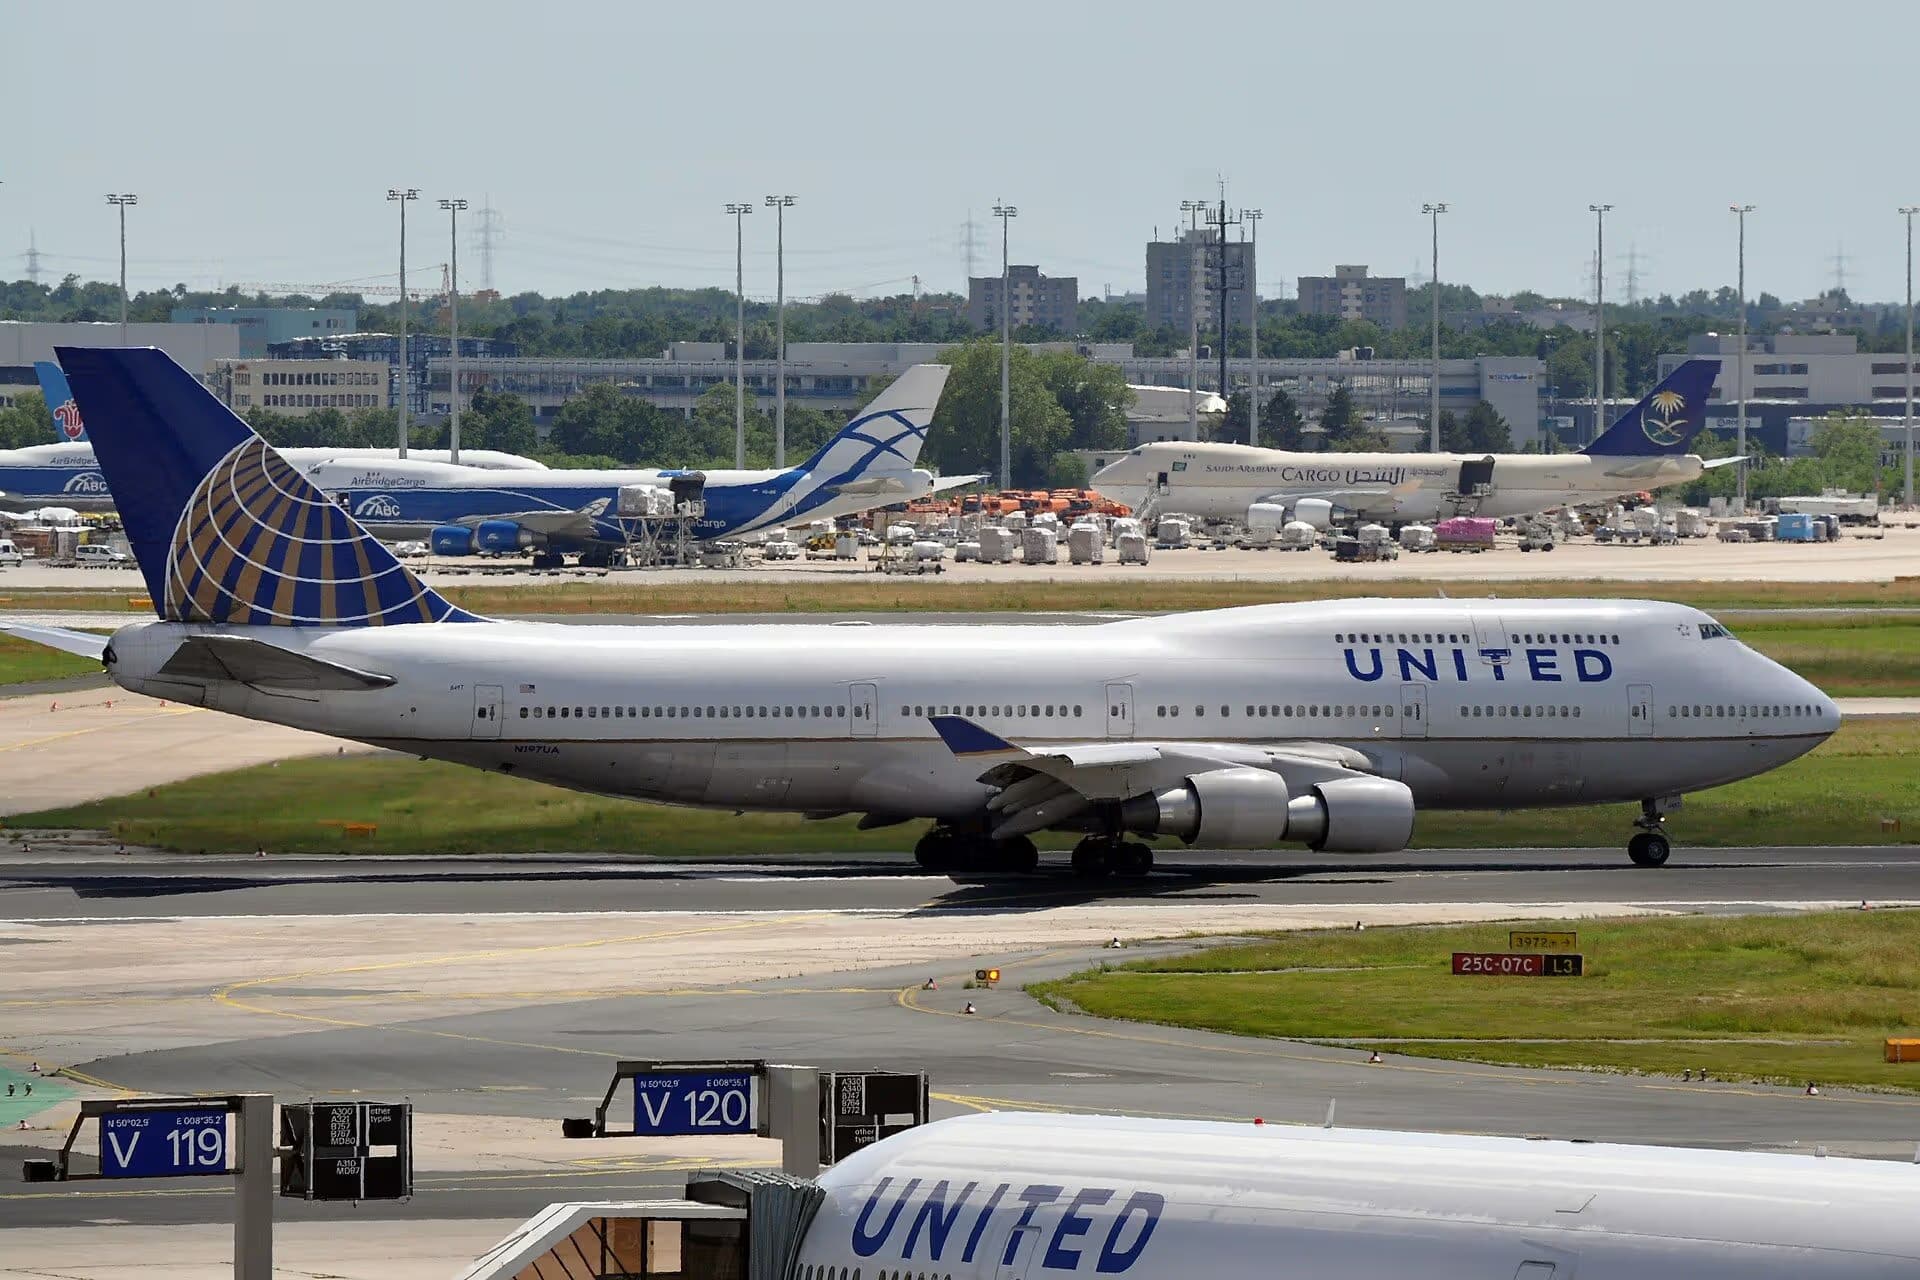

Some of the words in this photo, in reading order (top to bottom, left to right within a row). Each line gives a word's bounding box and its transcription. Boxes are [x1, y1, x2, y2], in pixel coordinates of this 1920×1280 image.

[1281, 467, 1340, 481] CARGO
[82, 482, 108, 492] ABC
[351, 477, 426, 488] AirBridgeCargo
[374, 505, 400, 516] ABC
[1344, 648, 1613, 682] UNITED
[514, 745, 560, 754] N197UA
[1462, 957, 1533, 972] 25C-07C
[1553, 959, 1573, 973] L3
[331, 1107, 353, 1115] A300
[641, 1092, 671, 1127] V
[684, 1090, 747, 1126] 120
[107, 1119, 114, 1127] N
[176, 1117, 182, 1125] E
[108, 1131, 140, 1168] V
[166, 1128, 222, 1166] 119
[851, 1176, 1165, 1274] UNITED
